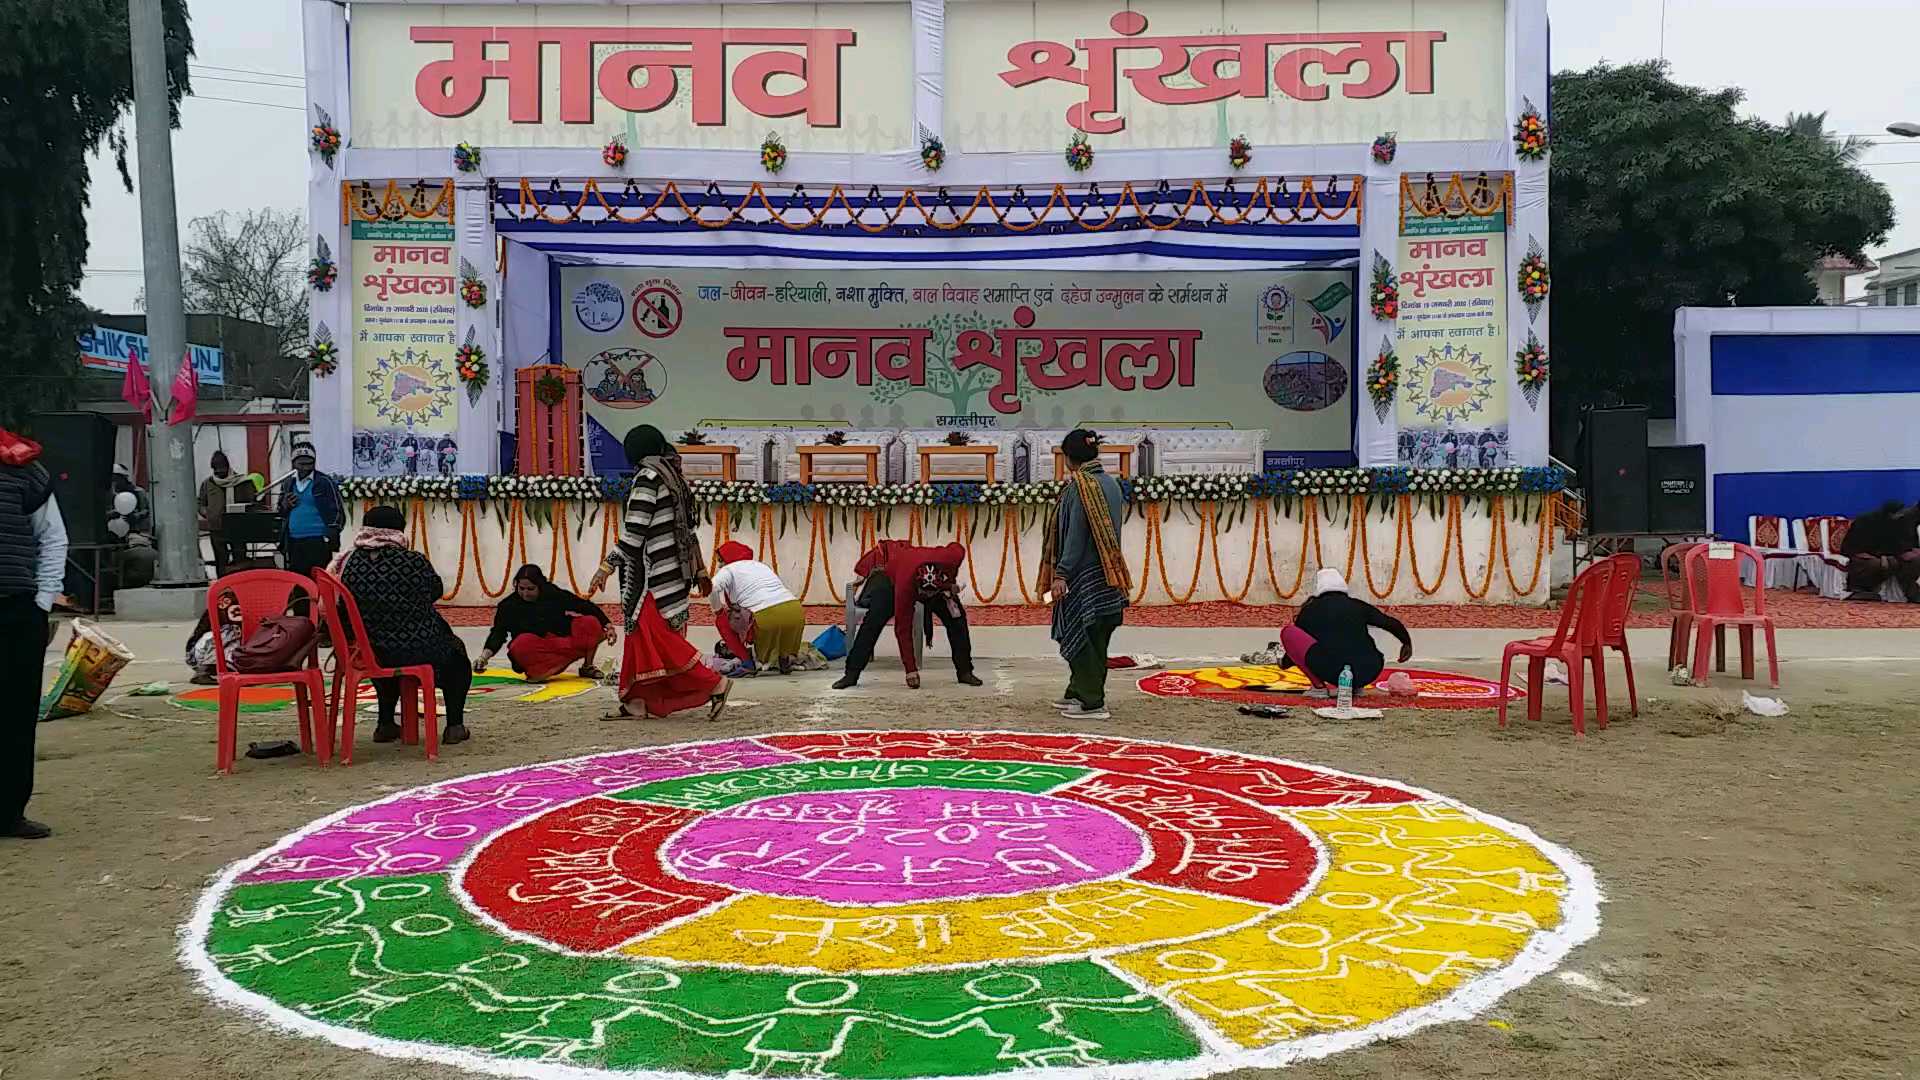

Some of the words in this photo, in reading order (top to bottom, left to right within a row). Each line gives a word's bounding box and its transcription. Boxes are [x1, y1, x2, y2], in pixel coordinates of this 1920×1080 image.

[410, 26, 857, 128] मानव
[373, 245, 452, 265] मानव
[1408, 239, 1489, 259] मानव
[835, 286, 866, 303] नशा
[868, 281, 908, 309] मुक्ति,
[912, 288, 939, 304] बाल
[942, 282, 980, 304] विवाह
[983, 282, 1031, 304] समाप्ति
[1034, 283, 1055, 308] एवं
[1061, 283, 1092, 305] दहेज
[1148, 283, 1164, 304] के
[1216, 283, 1229, 304] में
[359, 329, 368, 342] में
[373, 333, 405, 343] आपका
[410, 333, 445, 344] स्वागत
[1397, 327, 1405, 340] में
[1411, 328, 1444, 339] आपका
[1448, 326, 1484, 338] स्वागत
[723, 327, 933, 387] मानव
[924, 799, 1086, 823] मानव
[815, 820, 1049, 846] 2020
[733, 912, 953, 956] नशा
